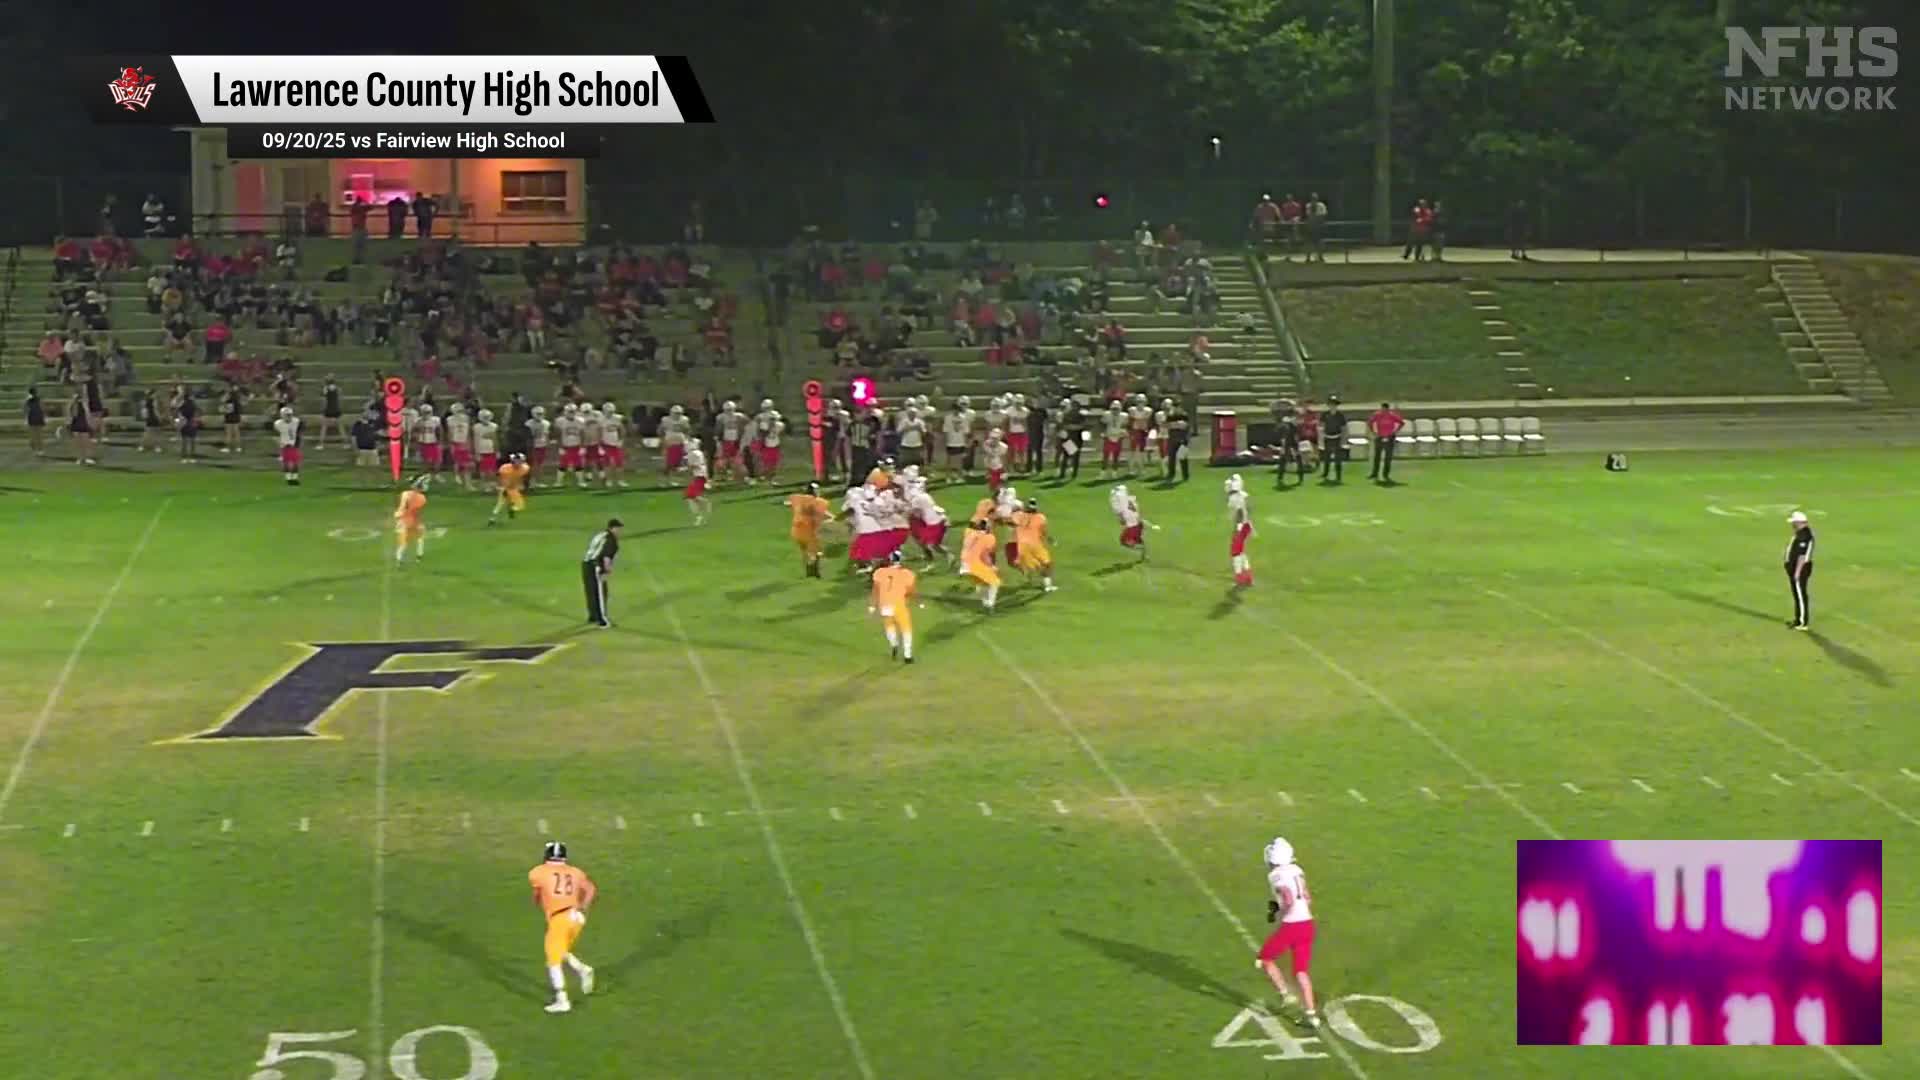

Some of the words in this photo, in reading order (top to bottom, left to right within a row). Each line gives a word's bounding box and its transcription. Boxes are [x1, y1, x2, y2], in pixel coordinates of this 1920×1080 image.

[154, 640, 572, 744] F
[552, 872, 574, 895] 28
[249, 1023, 499, 1080] 50
[1212, 993, 1442, 1061] 40
